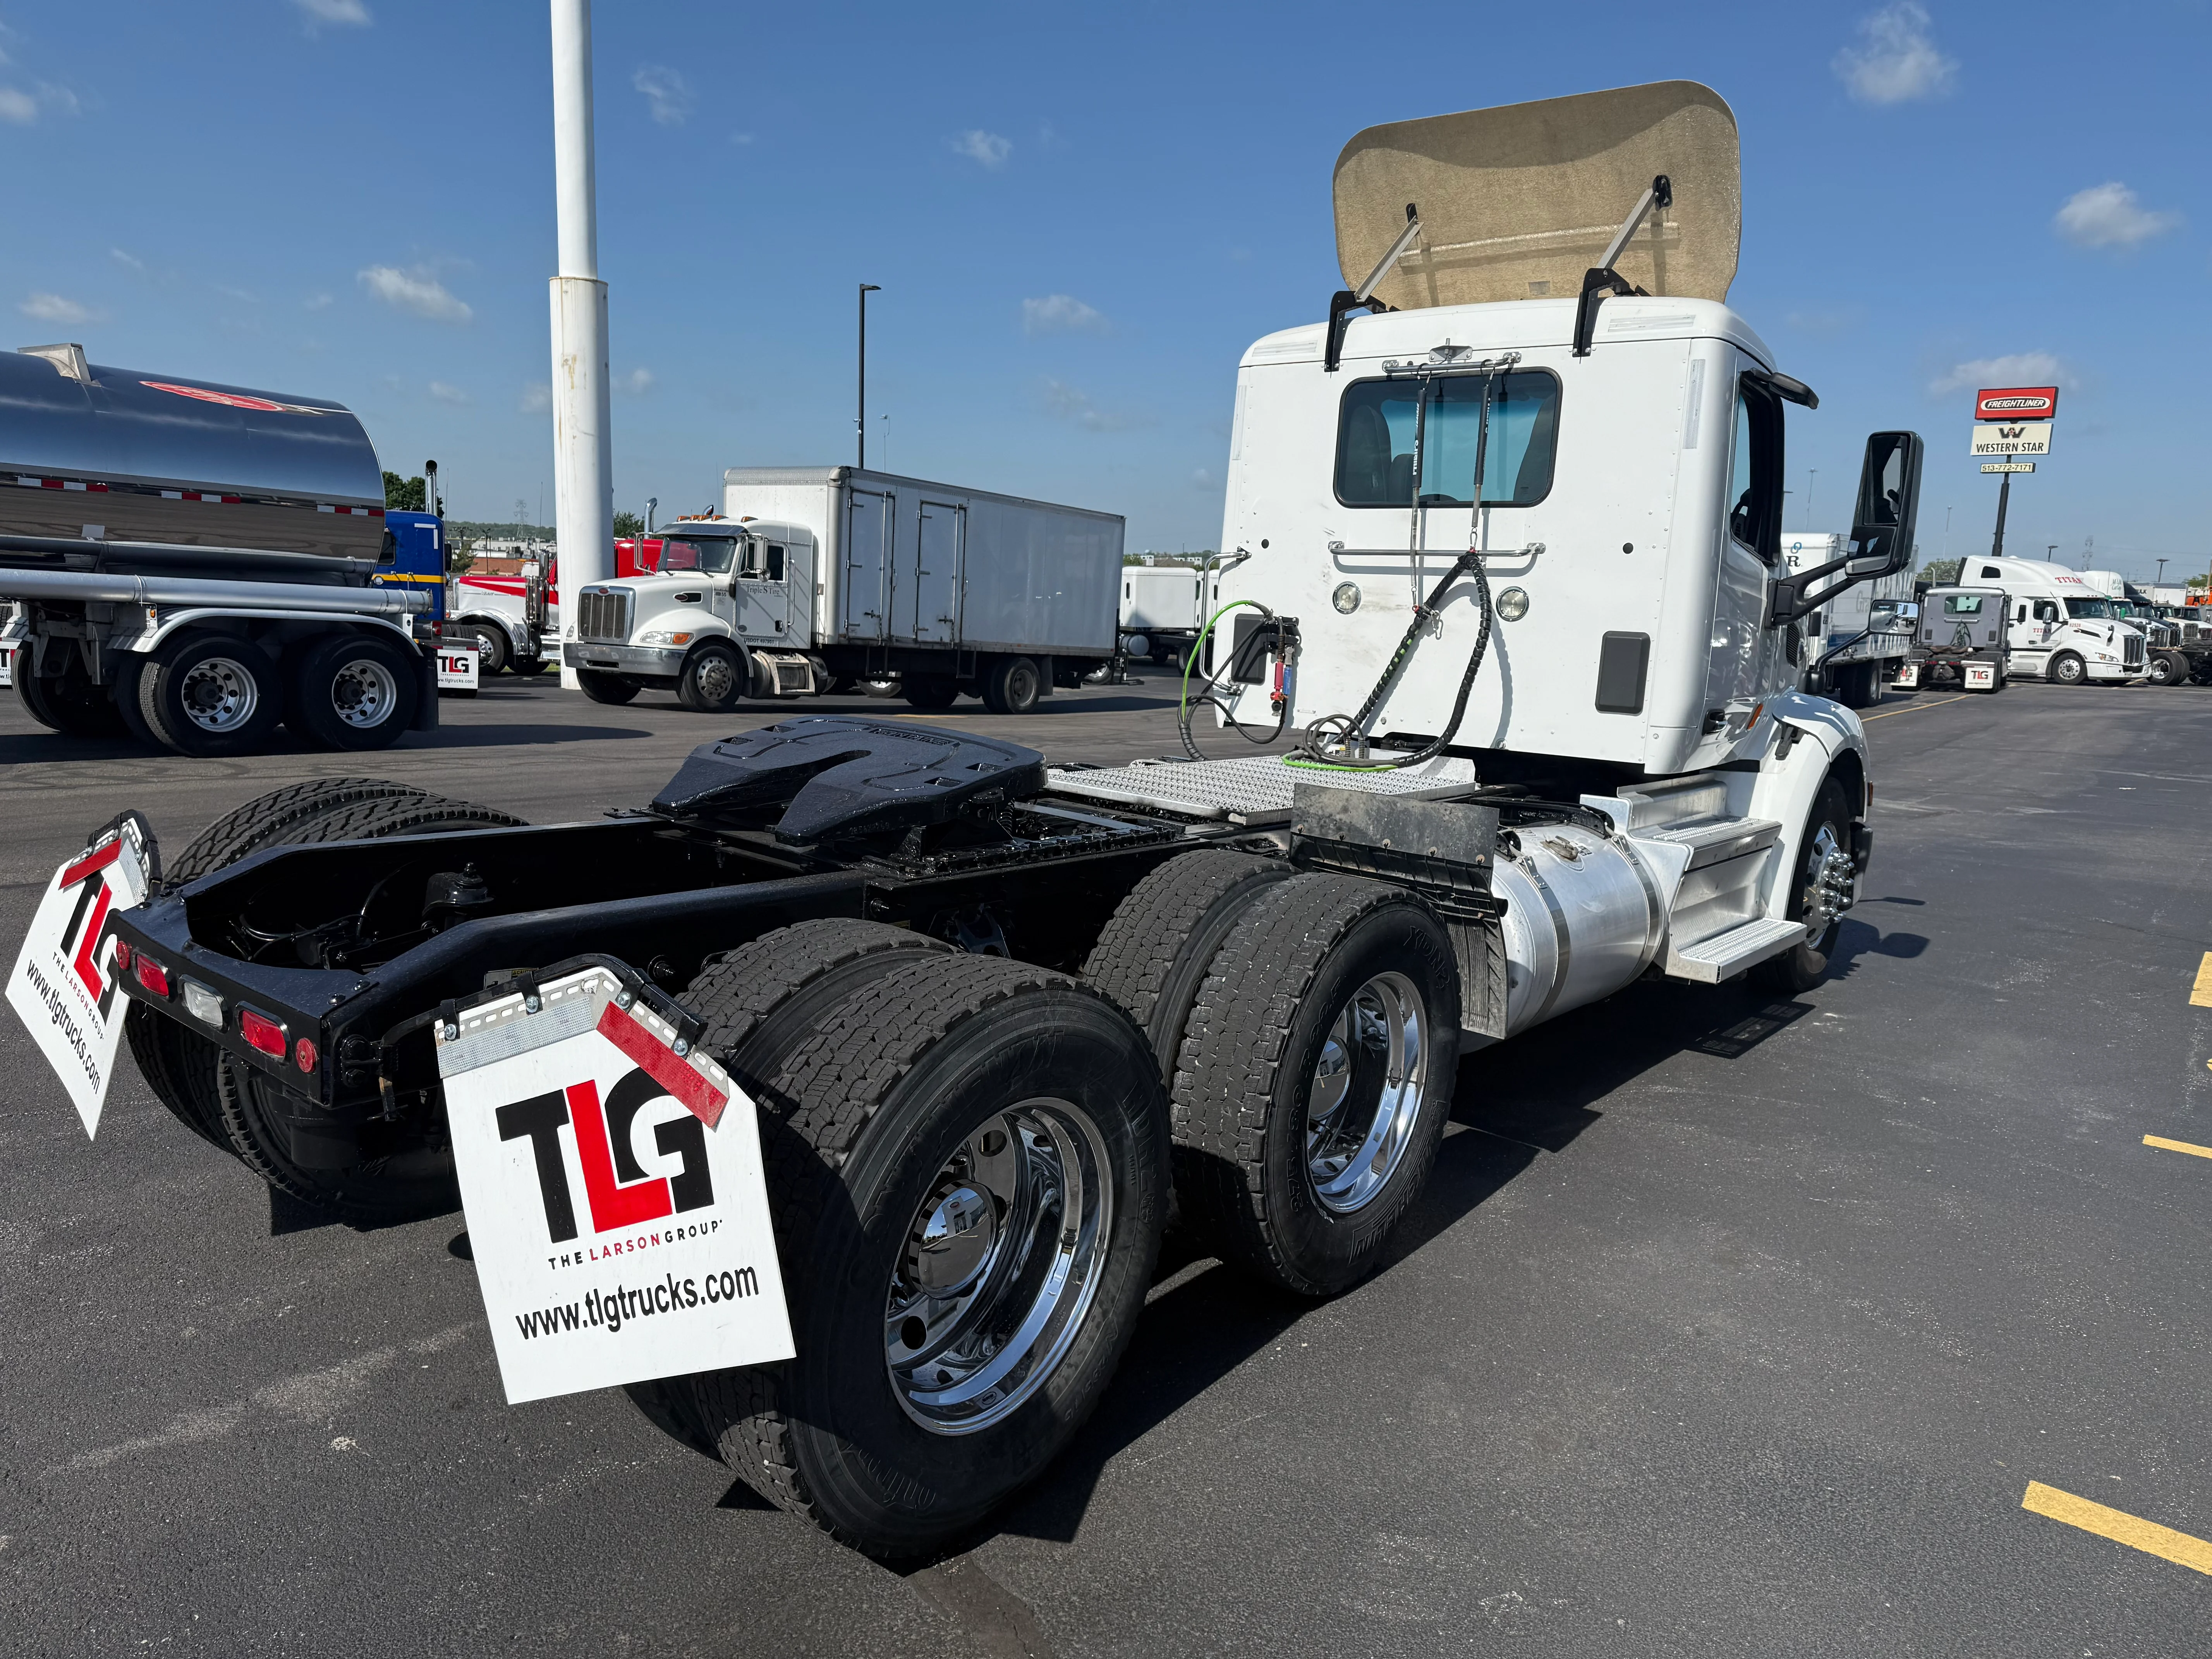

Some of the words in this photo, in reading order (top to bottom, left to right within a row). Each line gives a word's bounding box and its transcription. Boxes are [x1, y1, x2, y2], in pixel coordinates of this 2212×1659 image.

[1987, 399, 2044, 408] FREIGHTLINER
[1977, 443, 2018, 453] WESTERN
[2021, 442, 2044, 452] STAR
[438, 656, 469, 673] TLG
[1971, 671, 1988, 679] TLG
[53, 951, 65, 976] THE
[65, 969, 89, 1010] LARSON
[89, 1008, 103, 1039] GROUP
[27, 958, 101, 1094] www.tlgtrucks.com
[496, 1066, 714, 1244] TLG
[548, 1252, 583, 1270] THE
[589, 1233, 660, 1261] LARSON
[664, 1223, 718, 1243] GROUP
[515, 1263, 759, 1341] www.tlgtrucks.com
